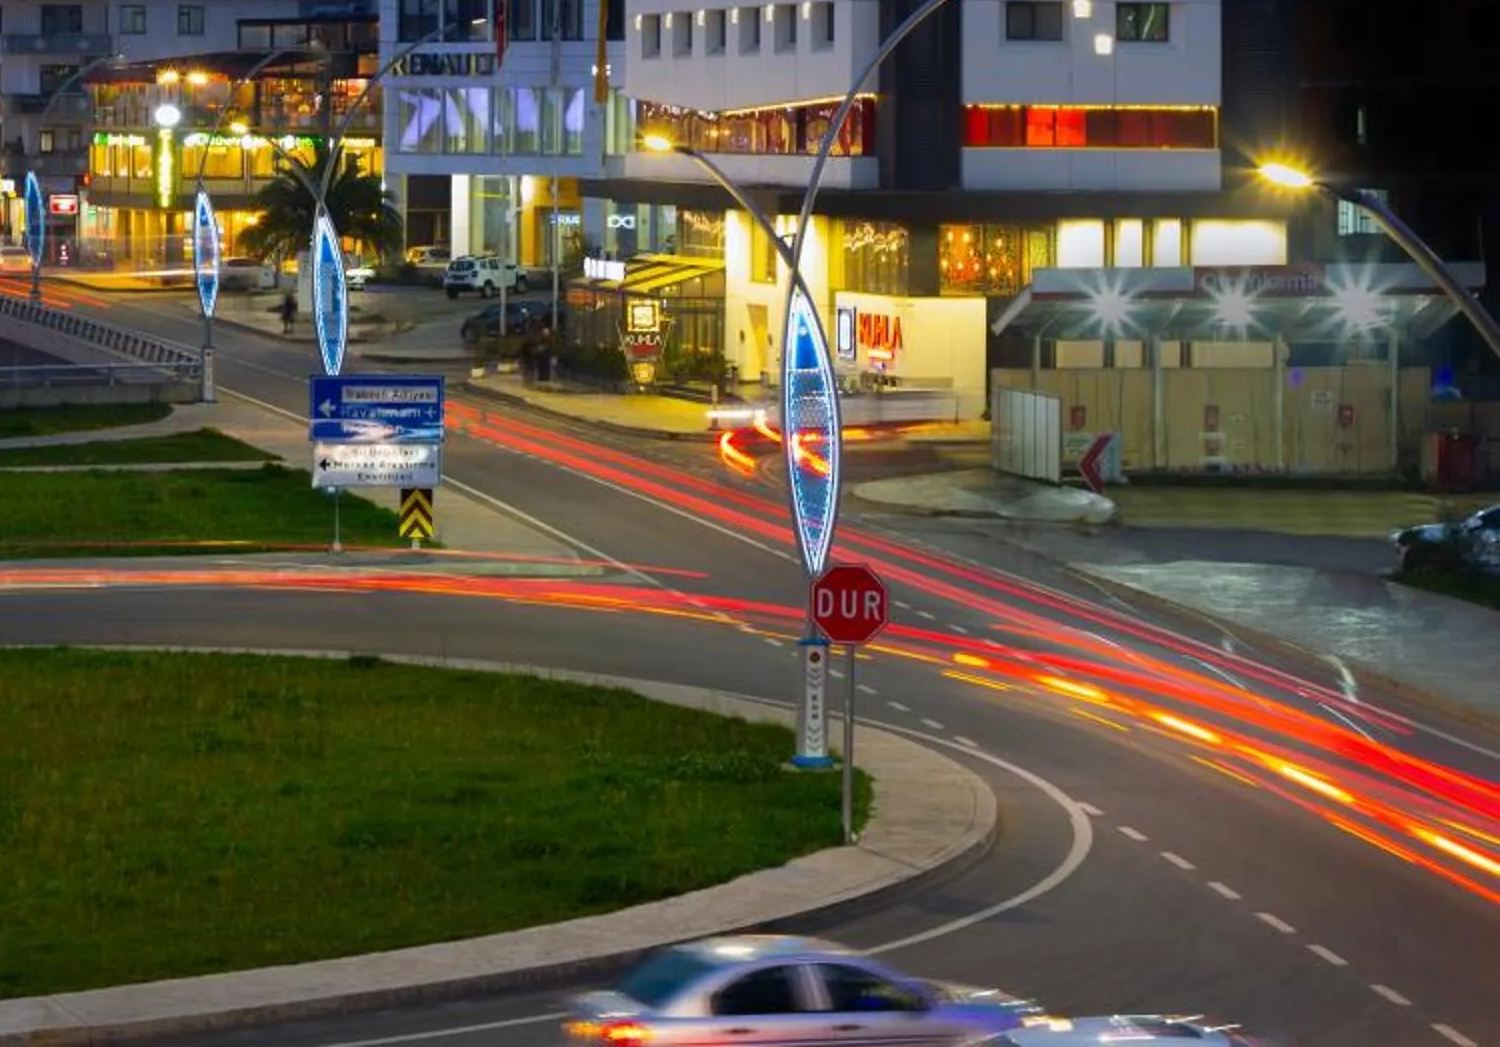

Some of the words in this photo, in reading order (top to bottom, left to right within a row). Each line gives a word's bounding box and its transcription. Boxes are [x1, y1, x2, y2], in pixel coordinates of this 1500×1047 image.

[626, 334, 662, 346] KUHLA
[858, 312, 904, 350] KUHLA
[817, 588, 881, 621] DUR
